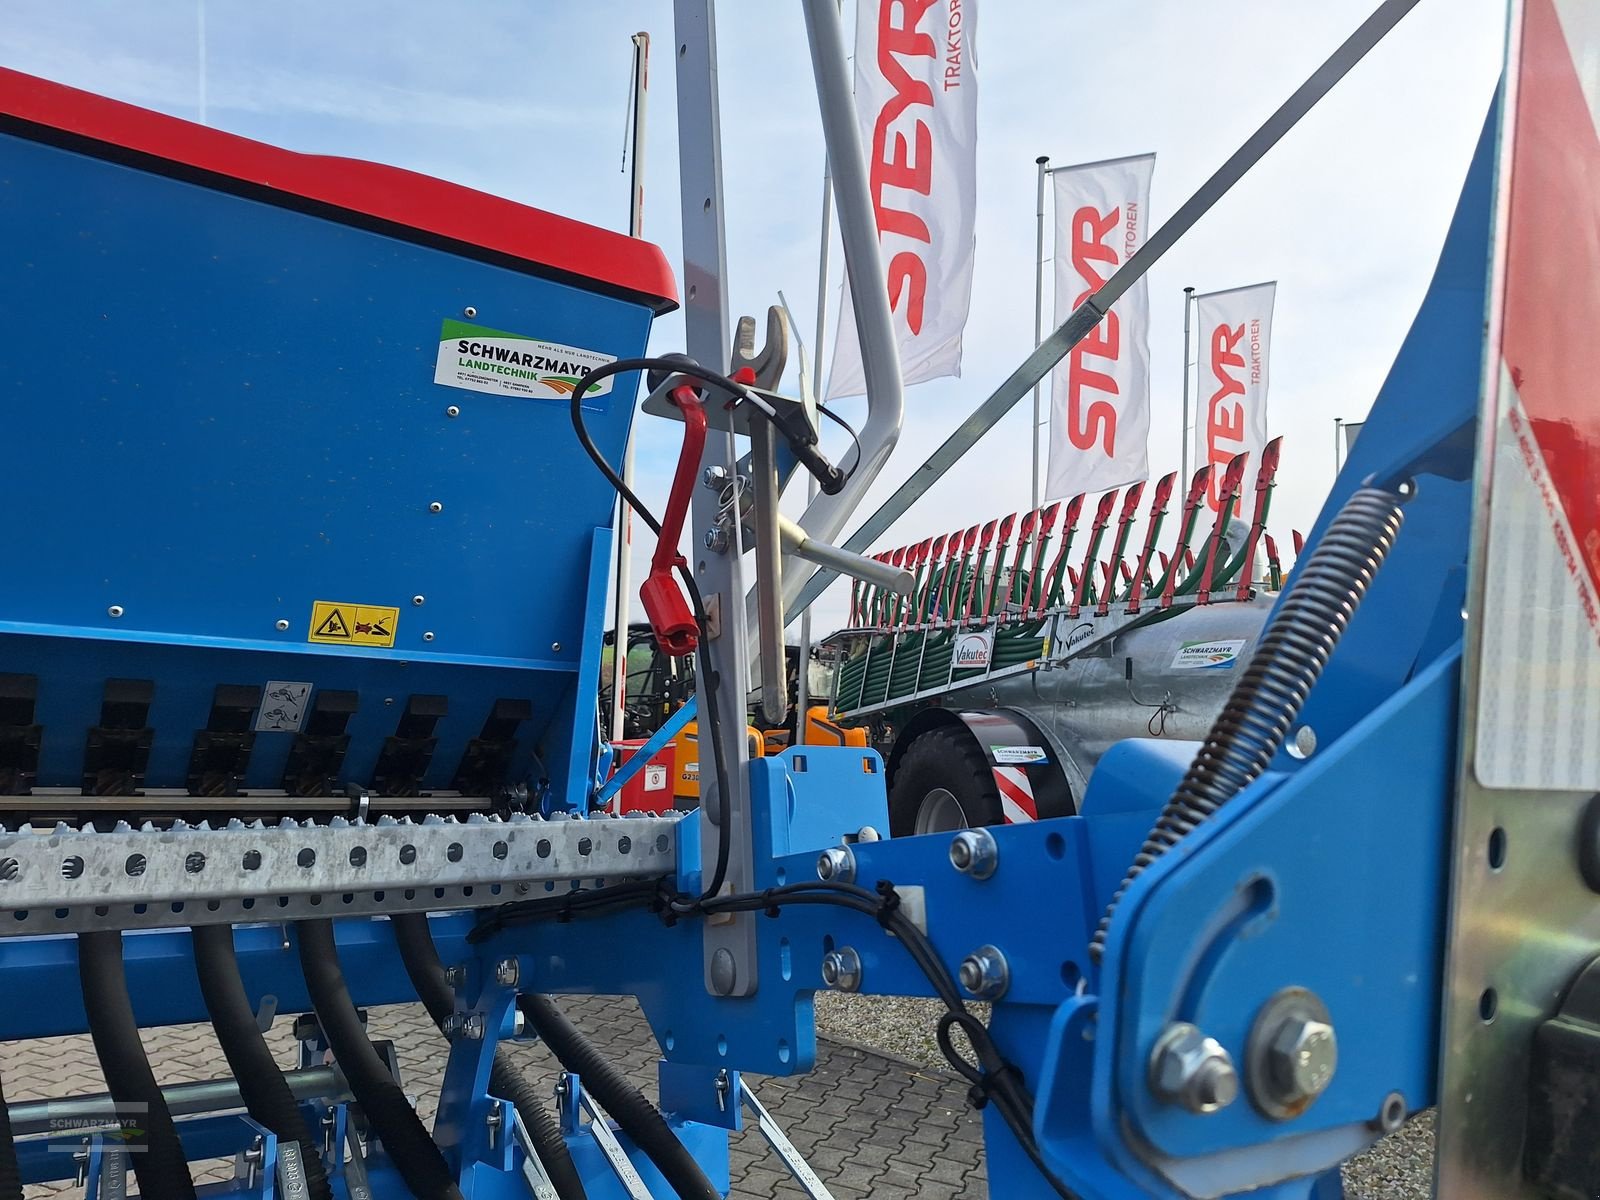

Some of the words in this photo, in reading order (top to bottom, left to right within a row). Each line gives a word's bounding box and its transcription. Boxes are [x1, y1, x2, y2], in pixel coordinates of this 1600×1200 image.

[1068, 205, 1120, 459] STEYR
[457, 340, 592, 377] SCHWARZMAYR
[1251, 319, 1260, 385] TRAKTOREN
[458, 357, 538, 381] LANDTECHNIK
[1065, 627, 1094, 651] Vakutec
[1182, 646, 1232, 654] SCHWARZMAYR
[957, 645, 988, 665] Vakutec
